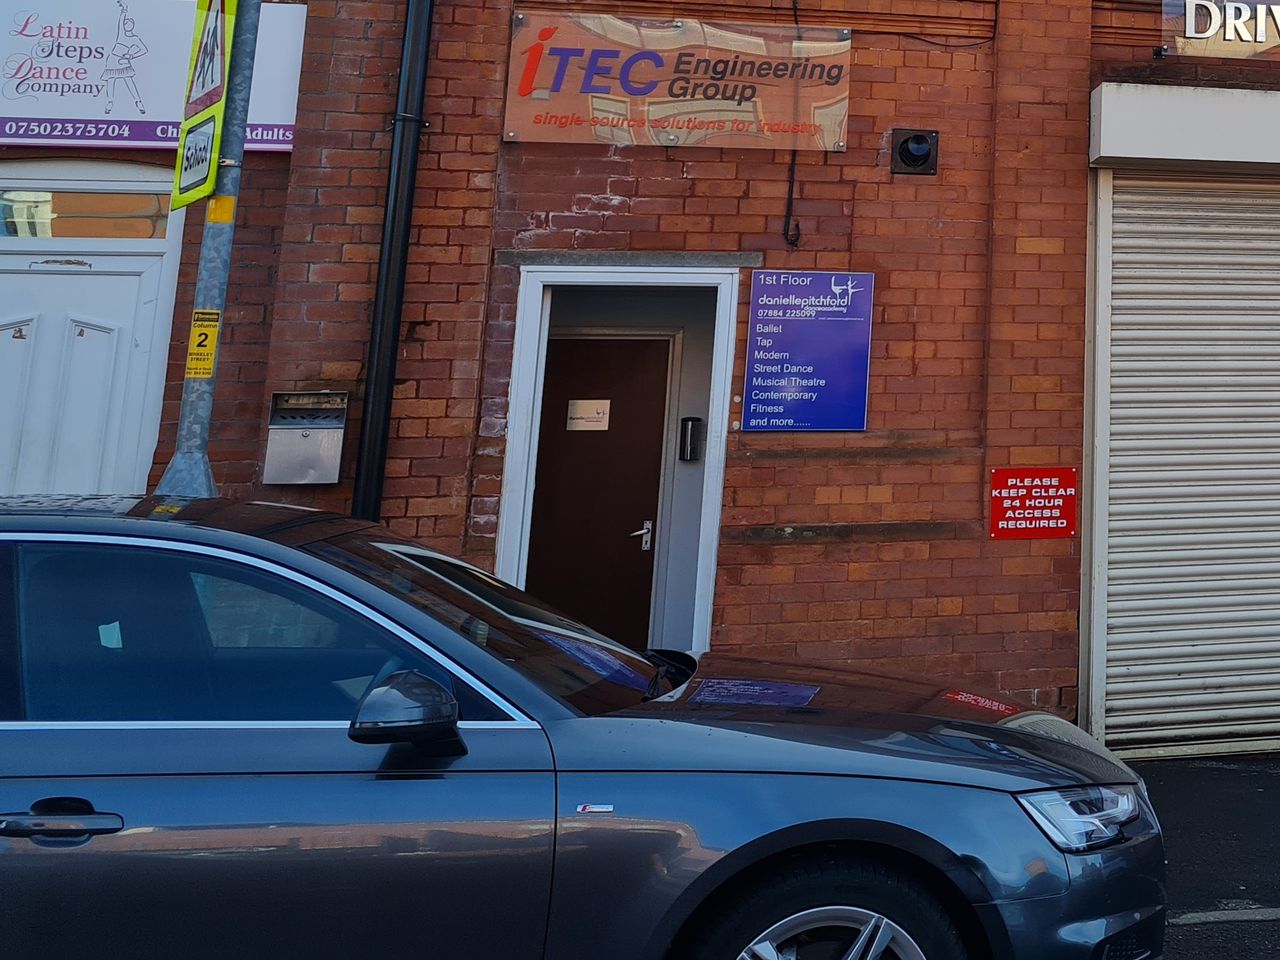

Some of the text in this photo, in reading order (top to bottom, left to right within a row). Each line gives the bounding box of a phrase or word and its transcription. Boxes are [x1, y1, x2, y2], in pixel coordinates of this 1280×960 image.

[10, 11, 89, 40] Latin
[32, 38, 104, 63] Steps
[4, 54, 87, 80] Dance
[673, 51, 844, 86] Engineering
[14, 77, 105, 98] Company
[668, 77, 757, 106] Group
[5, 121, 130, 137] 07502375704
[533, 111, 824, 136] single-source solutions for industry
[184, 136, 210, 172] School
[759, 274, 813, 286] 1st Floor
[758, 295, 848, 309] daniellepitchford
[757, 309, 783, 317] 07884
[756, 323, 783, 333] Ballet
[196, 332, 209, 348] 2
[756, 337, 773, 348] Tap
[754, 350, 789, 360] Modern
[754, 364, 813, 373] Street Dance
[752, 376, 826, 386] Musical Theatre
[752, 390, 818, 402] Contemporary
[750, 403, 784, 413] Fitness
[750, 416, 767, 426] and
[1008, 477, 1060, 486] PLEASE
[992, 488, 1075, 497] KEEP CLEAR
[1003, 499, 1020, 507] 24
[1005, 509, 1060, 518] ACCESS
[998, 520, 1067, 528] REQUIRED
